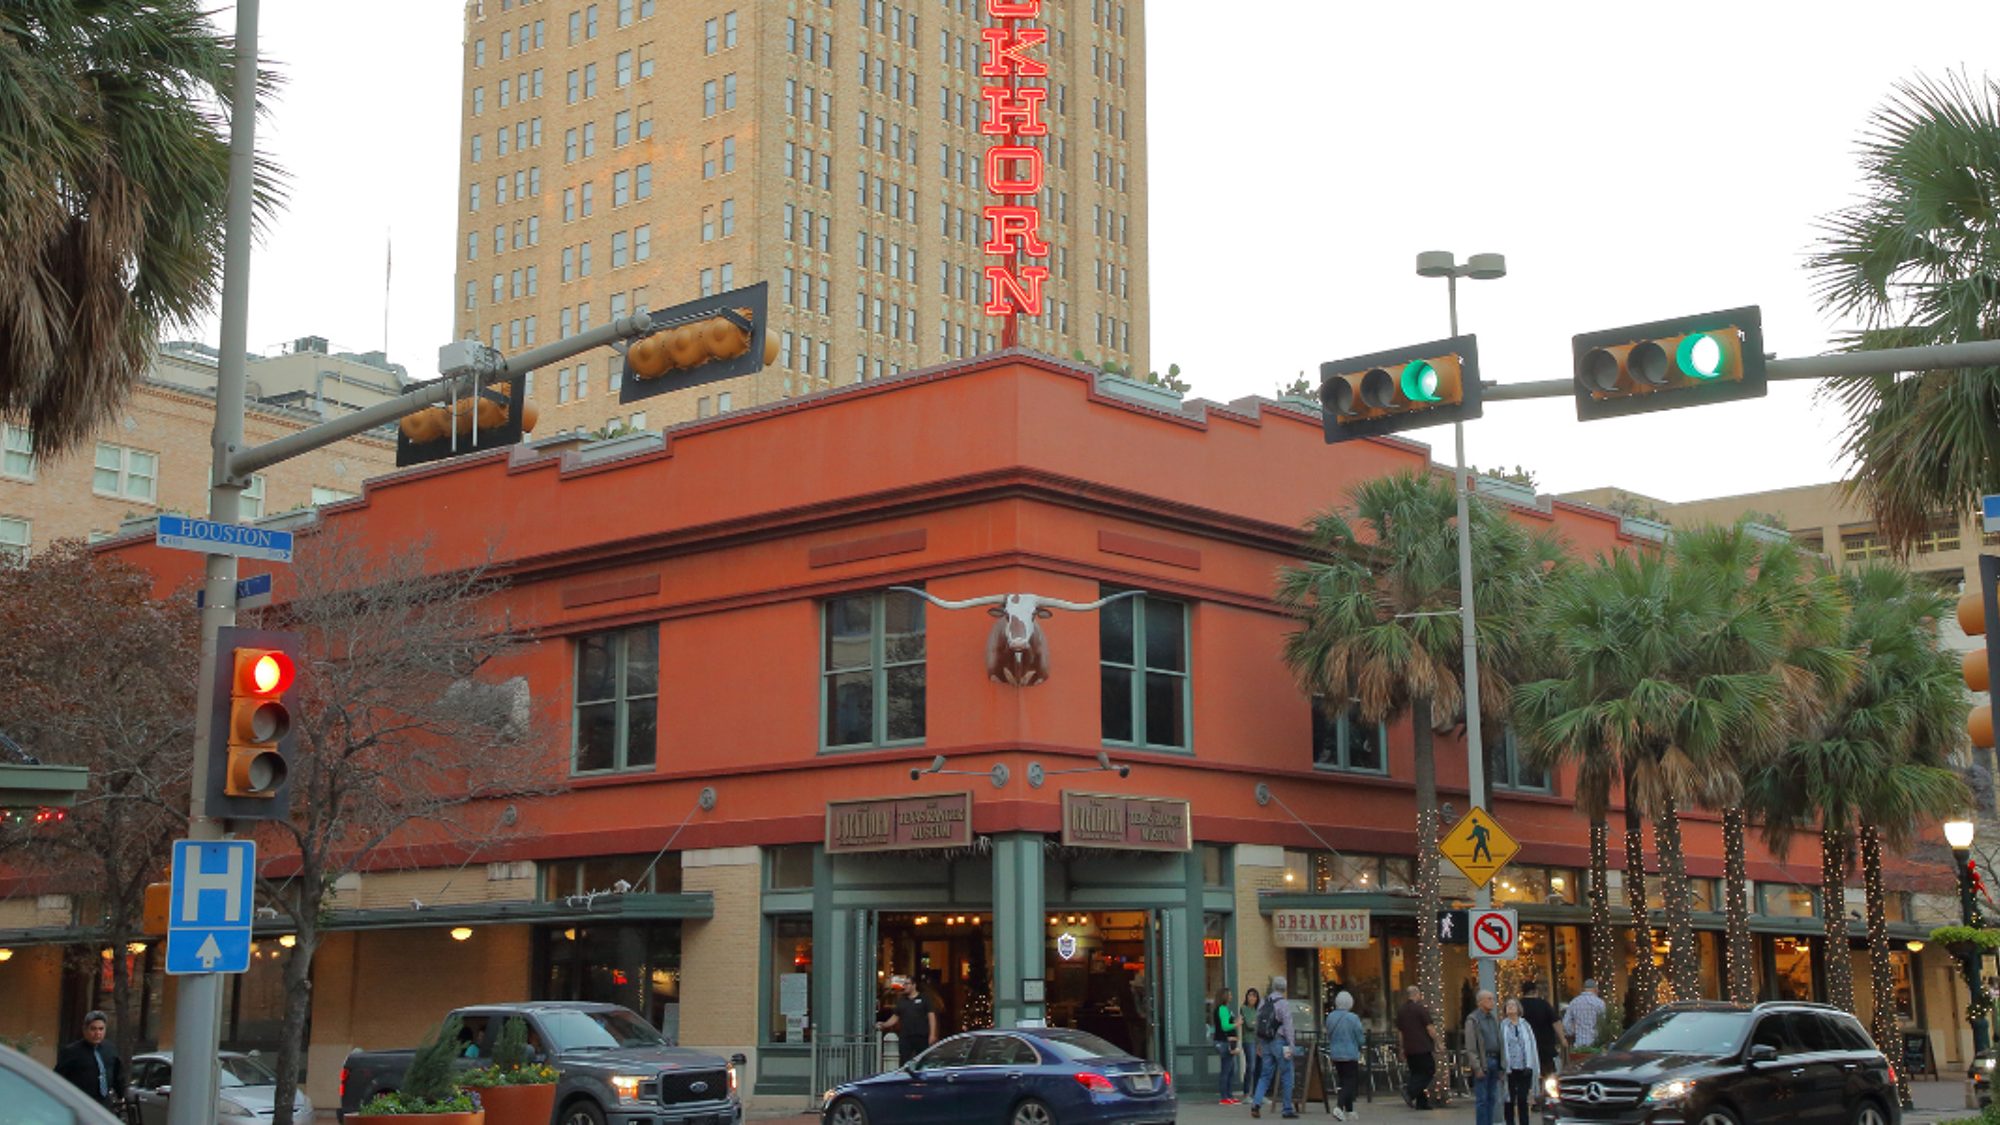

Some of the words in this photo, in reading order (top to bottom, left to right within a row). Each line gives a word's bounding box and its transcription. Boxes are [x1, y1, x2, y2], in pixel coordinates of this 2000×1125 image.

[180, 520, 272, 547] HOUSTON
[899, 810, 926, 825] TEXAS
[911, 824, 952, 840] MUSEUM
[1141, 828, 1175, 843] MUSEUM
[182, 845, 243, 921] H
[1277, 914, 1366, 930] BREAKFAST
